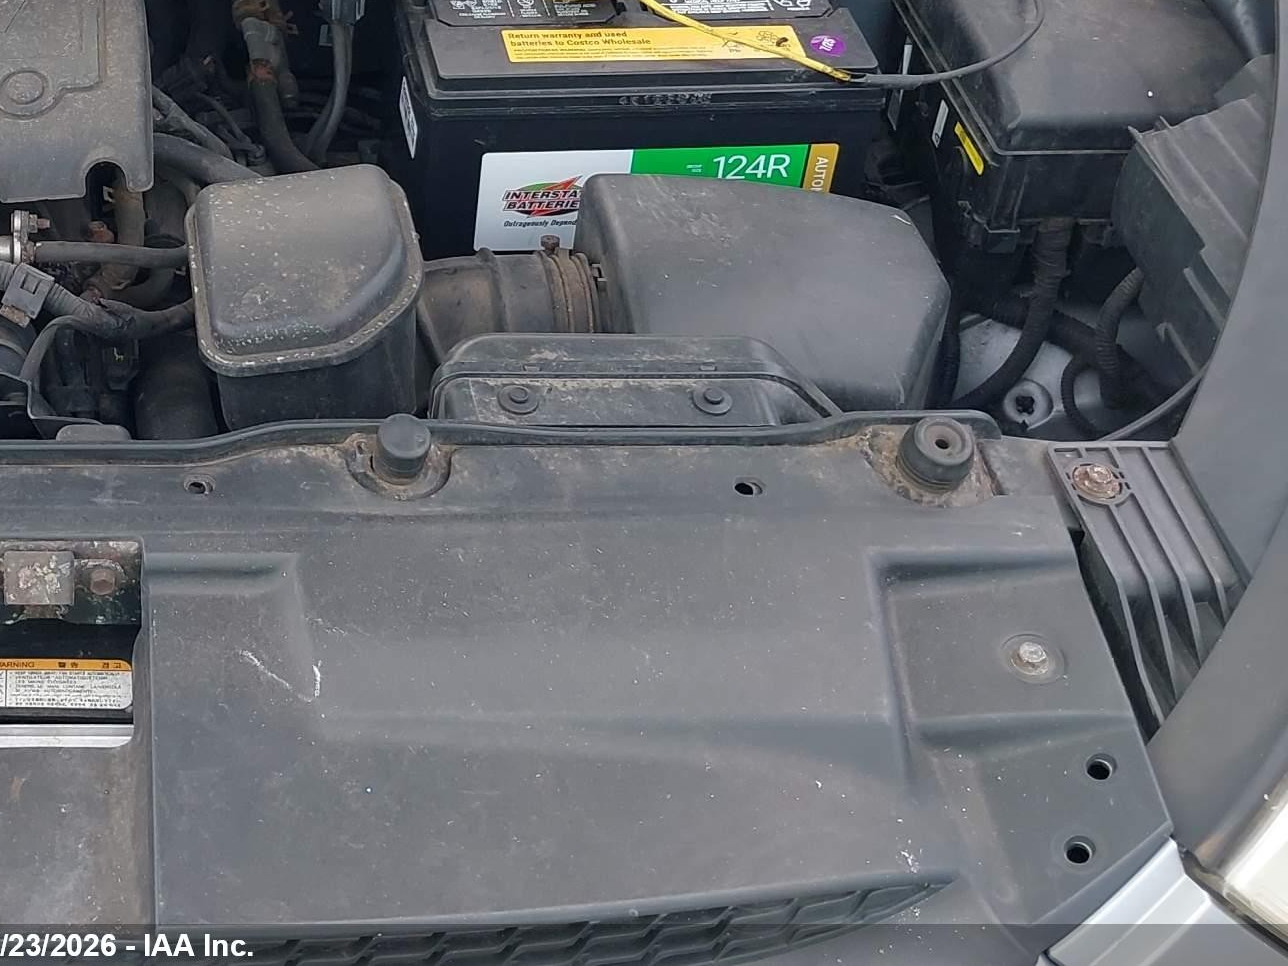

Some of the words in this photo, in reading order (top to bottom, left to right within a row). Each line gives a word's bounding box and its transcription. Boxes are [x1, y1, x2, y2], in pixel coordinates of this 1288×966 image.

[508, 32, 539, 40] Return
[542, 32, 582, 40] warranty
[510, 39, 553, 47] batteries
[602, 38, 652, 46] Wholesale
[713, 153, 791, 180] 124R
[505, 189, 580, 200] INTERSTA
[506, 200, 579, 210] BATTERIE
[503, 219, 549, 228] Outrageously
